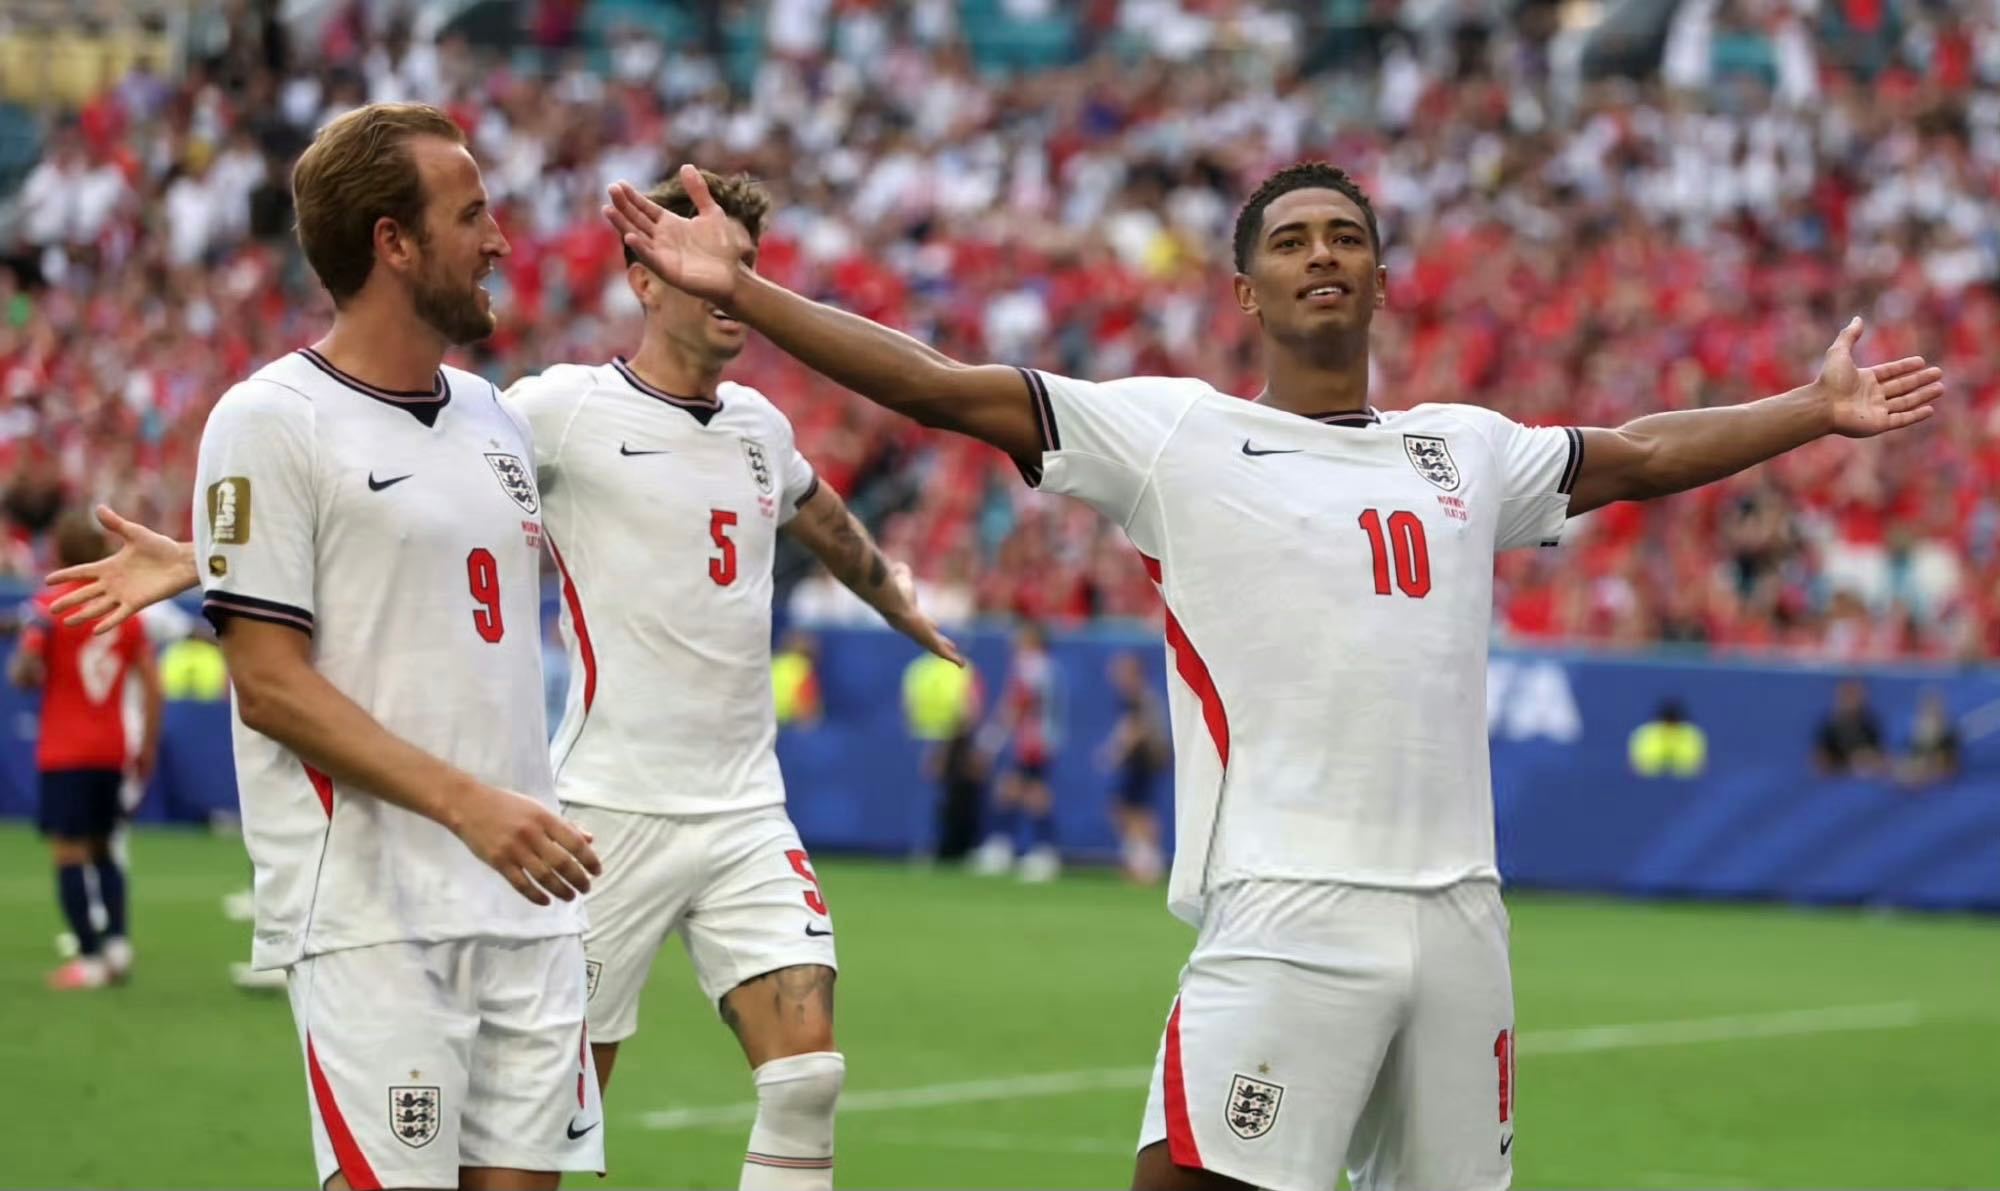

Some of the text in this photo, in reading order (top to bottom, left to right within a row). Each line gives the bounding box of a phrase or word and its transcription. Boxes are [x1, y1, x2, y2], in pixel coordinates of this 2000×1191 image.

[709, 508, 737, 587] 5
[1358, 508, 1431, 599] 10
[467, 547, 504, 644] 9
[784, 849, 828, 917] 5
[1494, 1025, 1514, 1123] 1
